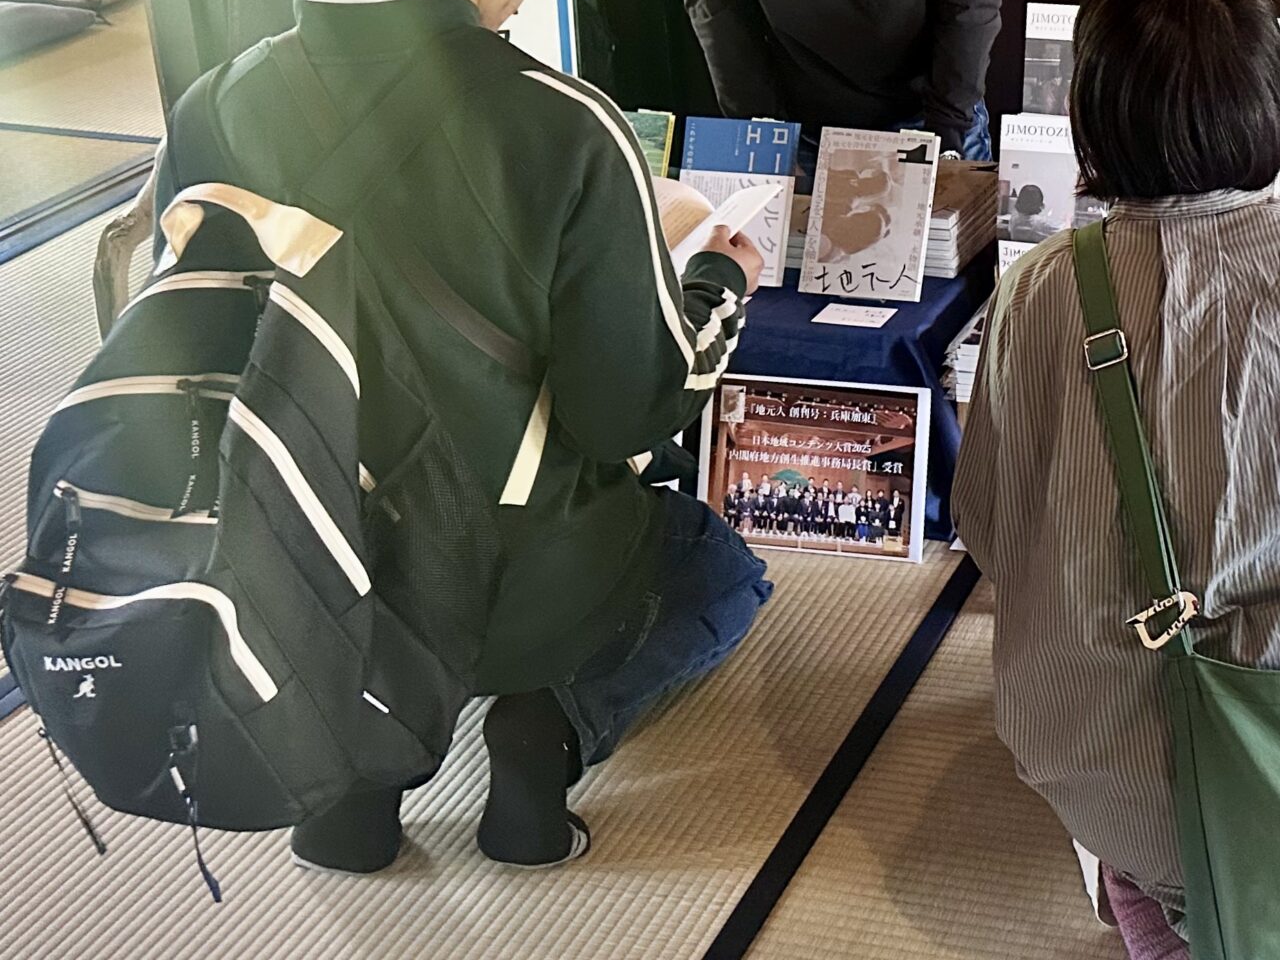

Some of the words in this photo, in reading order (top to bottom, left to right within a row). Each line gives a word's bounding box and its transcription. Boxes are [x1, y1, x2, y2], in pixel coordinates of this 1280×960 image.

[814, 263, 921, 293] 地元人
[191, 420, 200, 459] KANGOL
[179, 474, 197, 512] KANGOL
[62, 532, 78, 573] KANGOL
[47, 586, 66, 625] KANGOL
[43, 654, 123, 672] KANGOL
